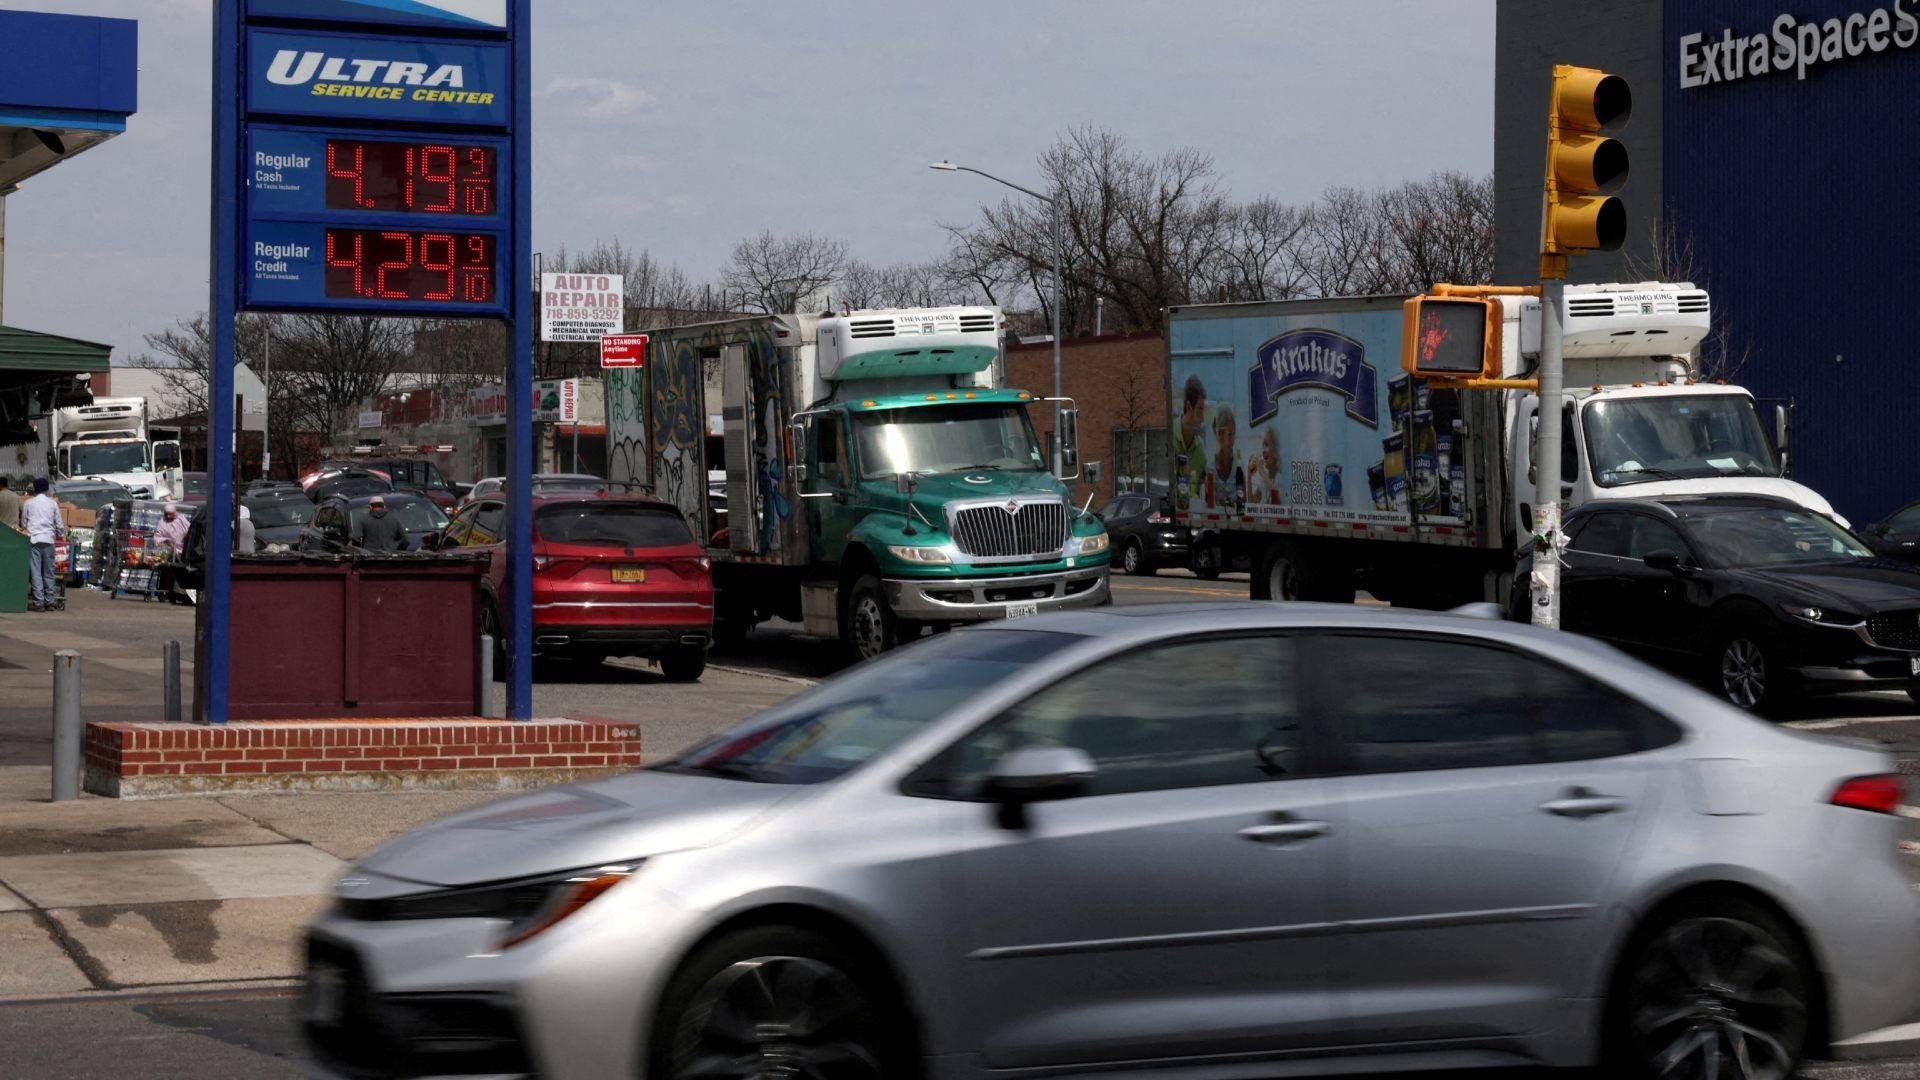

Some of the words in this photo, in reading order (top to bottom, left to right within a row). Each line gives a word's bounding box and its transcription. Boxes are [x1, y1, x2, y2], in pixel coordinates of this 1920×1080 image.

[266, 50, 464, 88] ULTRA
[311, 83, 404, 100] SERVICE
[412, 89, 495, 105] CENTER
[255, 151, 311, 170] Regular
[255, 170, 283, 183] Cash
[328, 144, 455, 213] 4.19
[254, 241, 310, 260] Regular
[254, 260, 288, 273] Credit
[327, 233, 455, 300] 4.29
[554, 275, 610, 291] AUTO
[545, 292, 619, 308] REPAIR
[546, 308, 620, 320] 718-859-5292
[1272, 339, 1347, 380] Krakus
[564, 381, 574, 397] AUTO
[564, 398, 574, 419] REPAIR
[1291, 461, 1320, 482] PRIME
[1291, 482, 1323, 505] CHOICE
